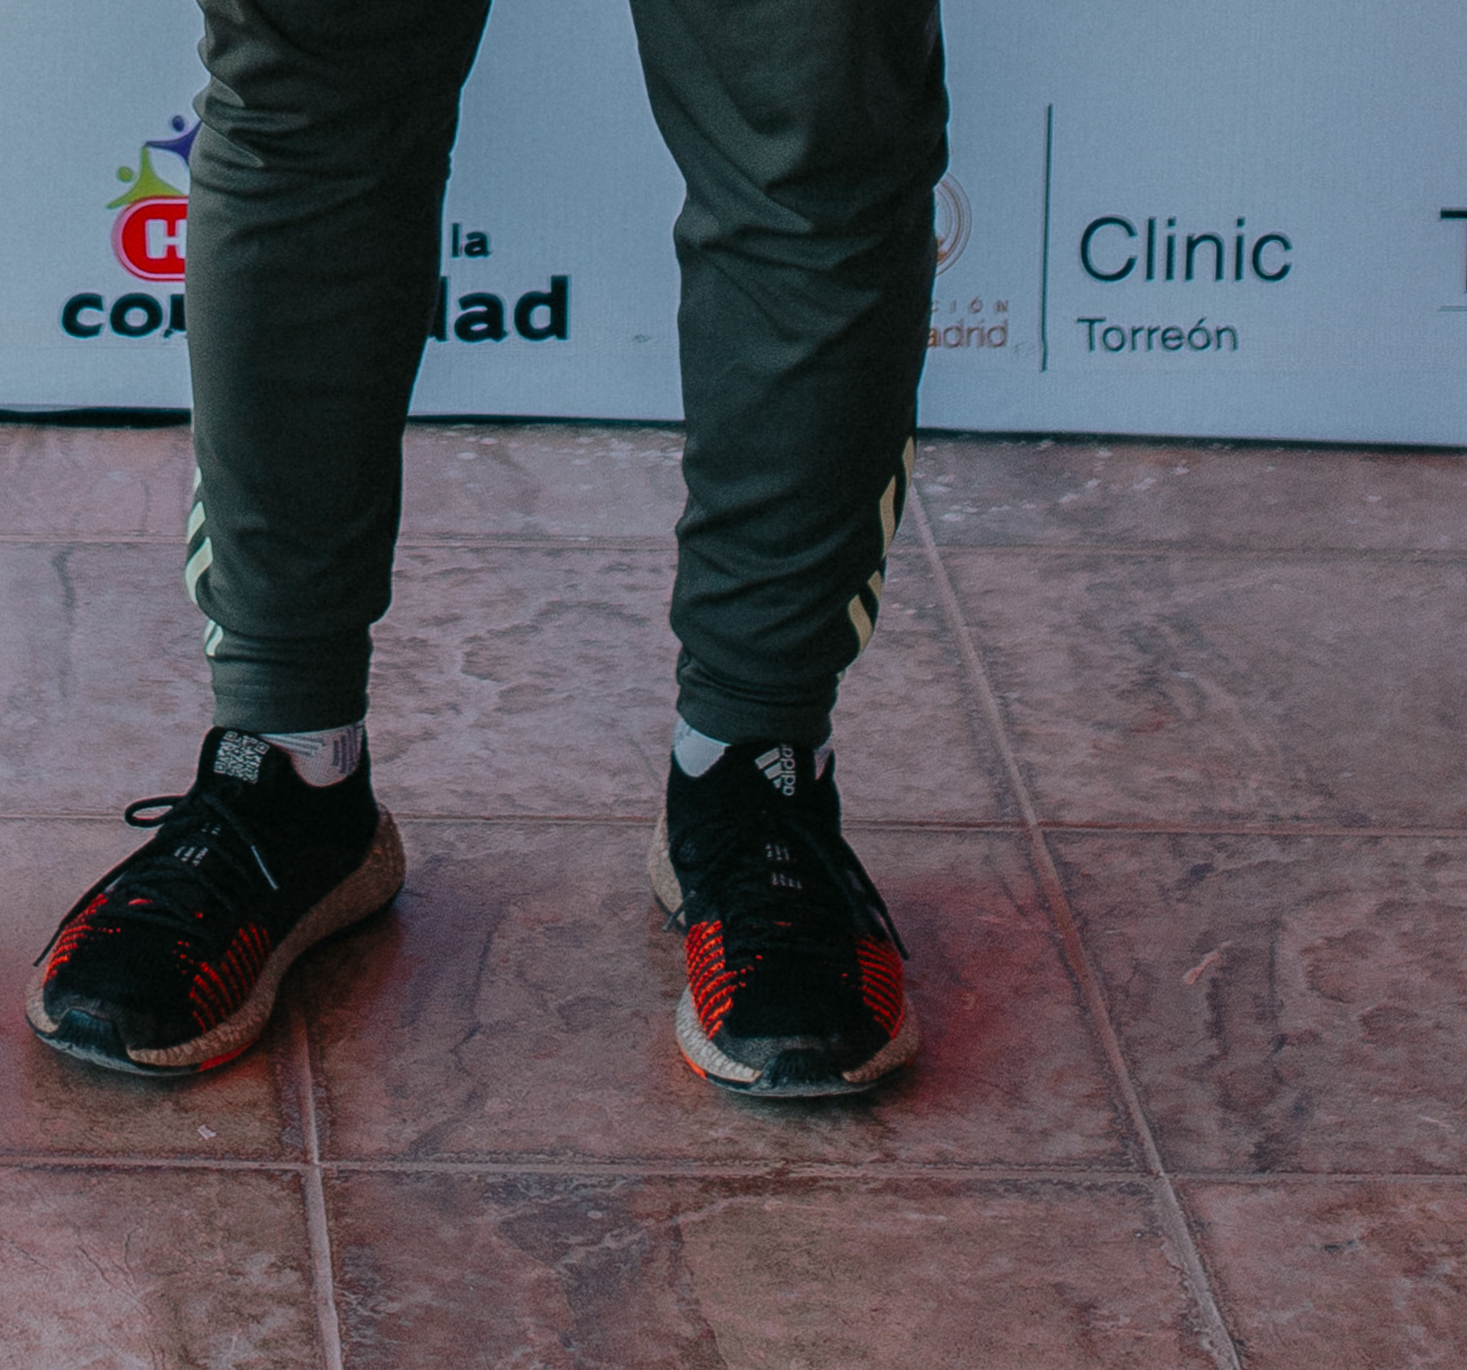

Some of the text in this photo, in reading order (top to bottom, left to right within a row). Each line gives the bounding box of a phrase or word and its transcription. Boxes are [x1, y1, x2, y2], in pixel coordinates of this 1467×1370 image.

[451, 222, 490, 258] la
[1079, 216, 1292, 282] Clinic
[1076, 317, 1238, 353] Torreón
[780, 743, 796, 796] adida
